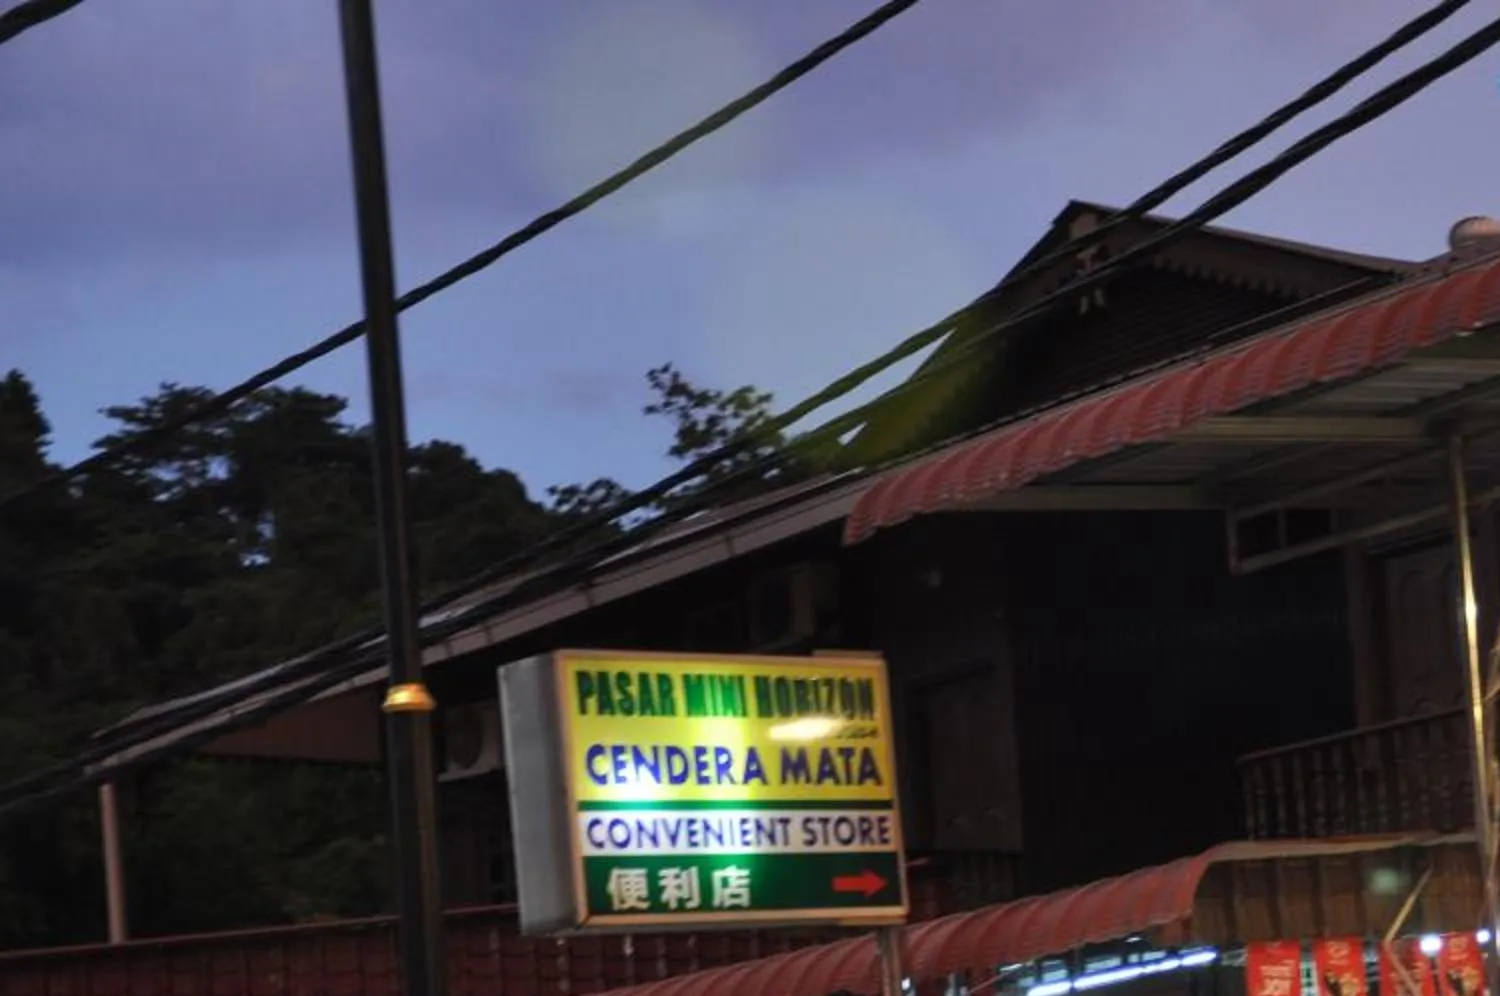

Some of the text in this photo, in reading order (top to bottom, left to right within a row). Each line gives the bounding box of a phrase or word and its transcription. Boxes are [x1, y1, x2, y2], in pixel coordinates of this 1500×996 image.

[575, 670, 875, 721] PASAR MINI HORIZON
[586, 744, 883, 786] CENDERA MATA
[587, 815, 892, 849] CONVENIENT STORE
[607, 864, 752, 911] 便利店
